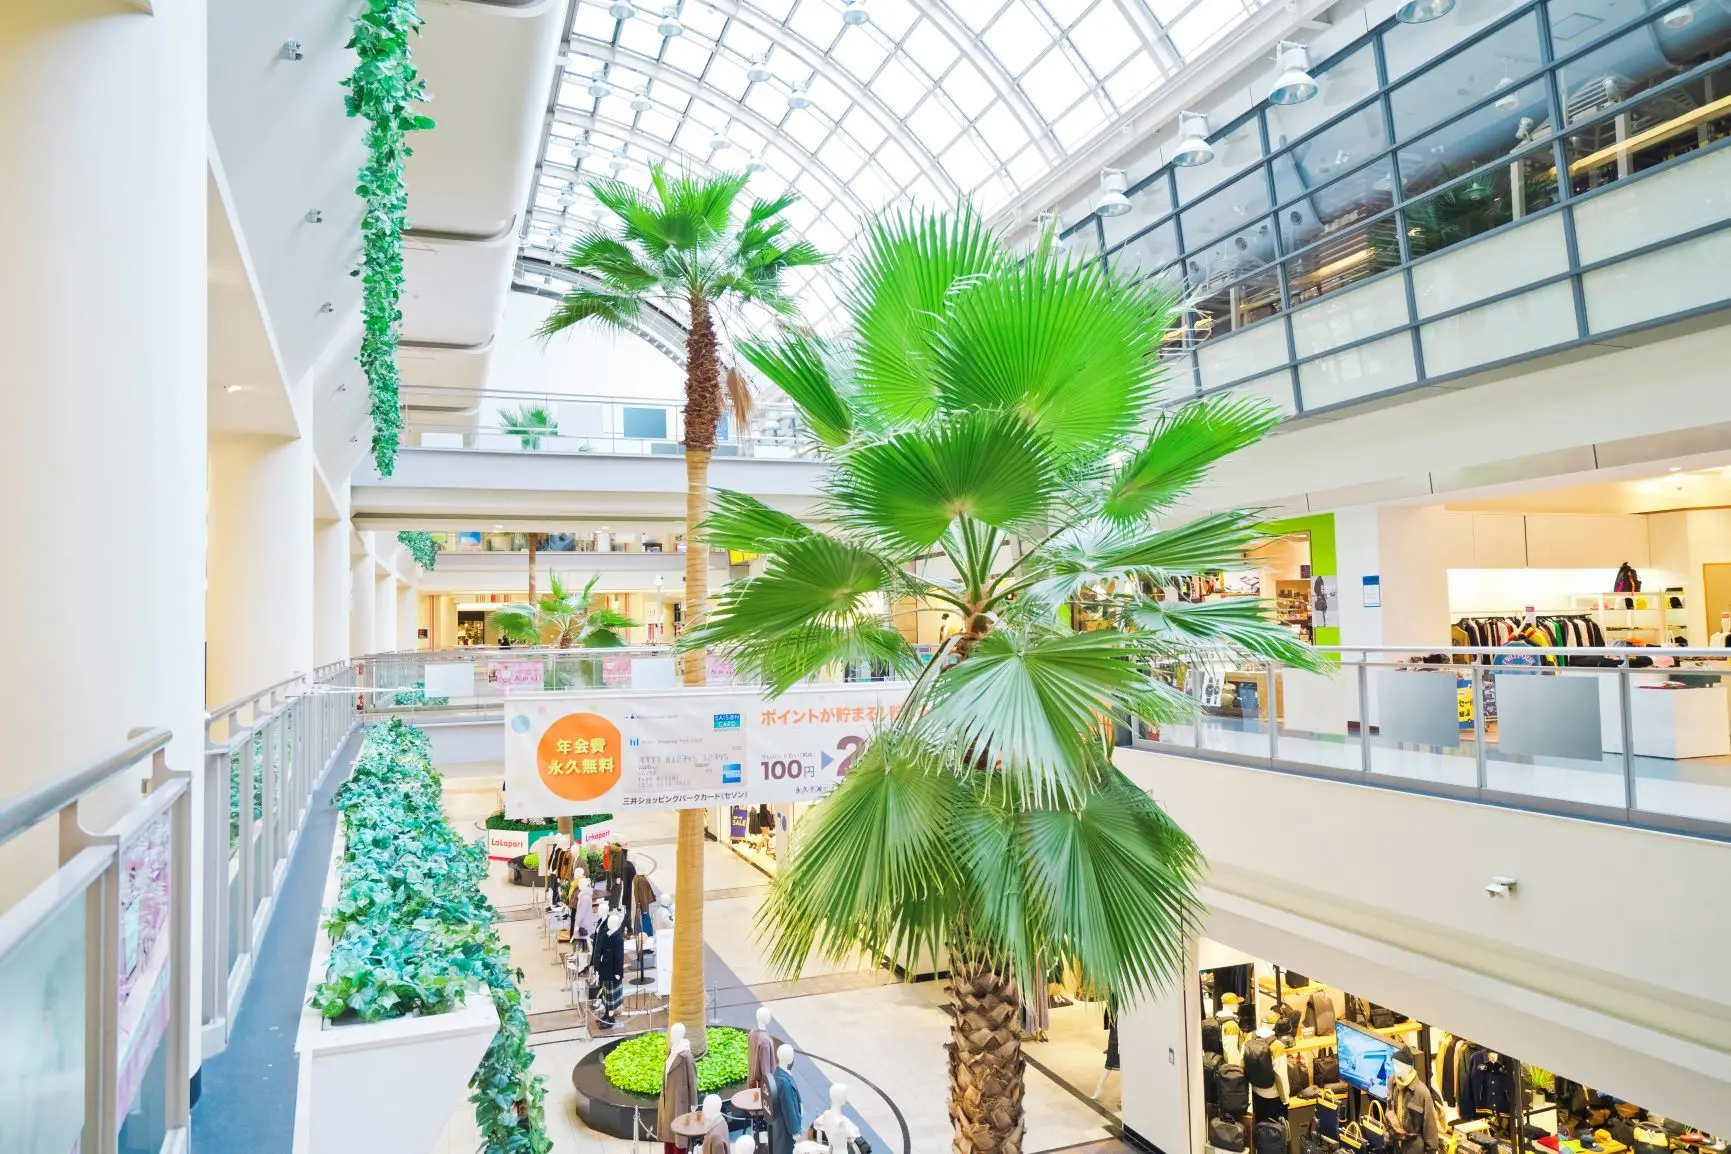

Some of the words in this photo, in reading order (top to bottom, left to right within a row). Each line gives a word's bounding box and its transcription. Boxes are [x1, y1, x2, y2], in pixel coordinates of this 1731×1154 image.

[556, 737, 606, 755] 年会費
[548, 756, 614, 775] 永久無料
[732, 819, 746, 827] SALE
[491, 838, 523, 849] LaLaport
